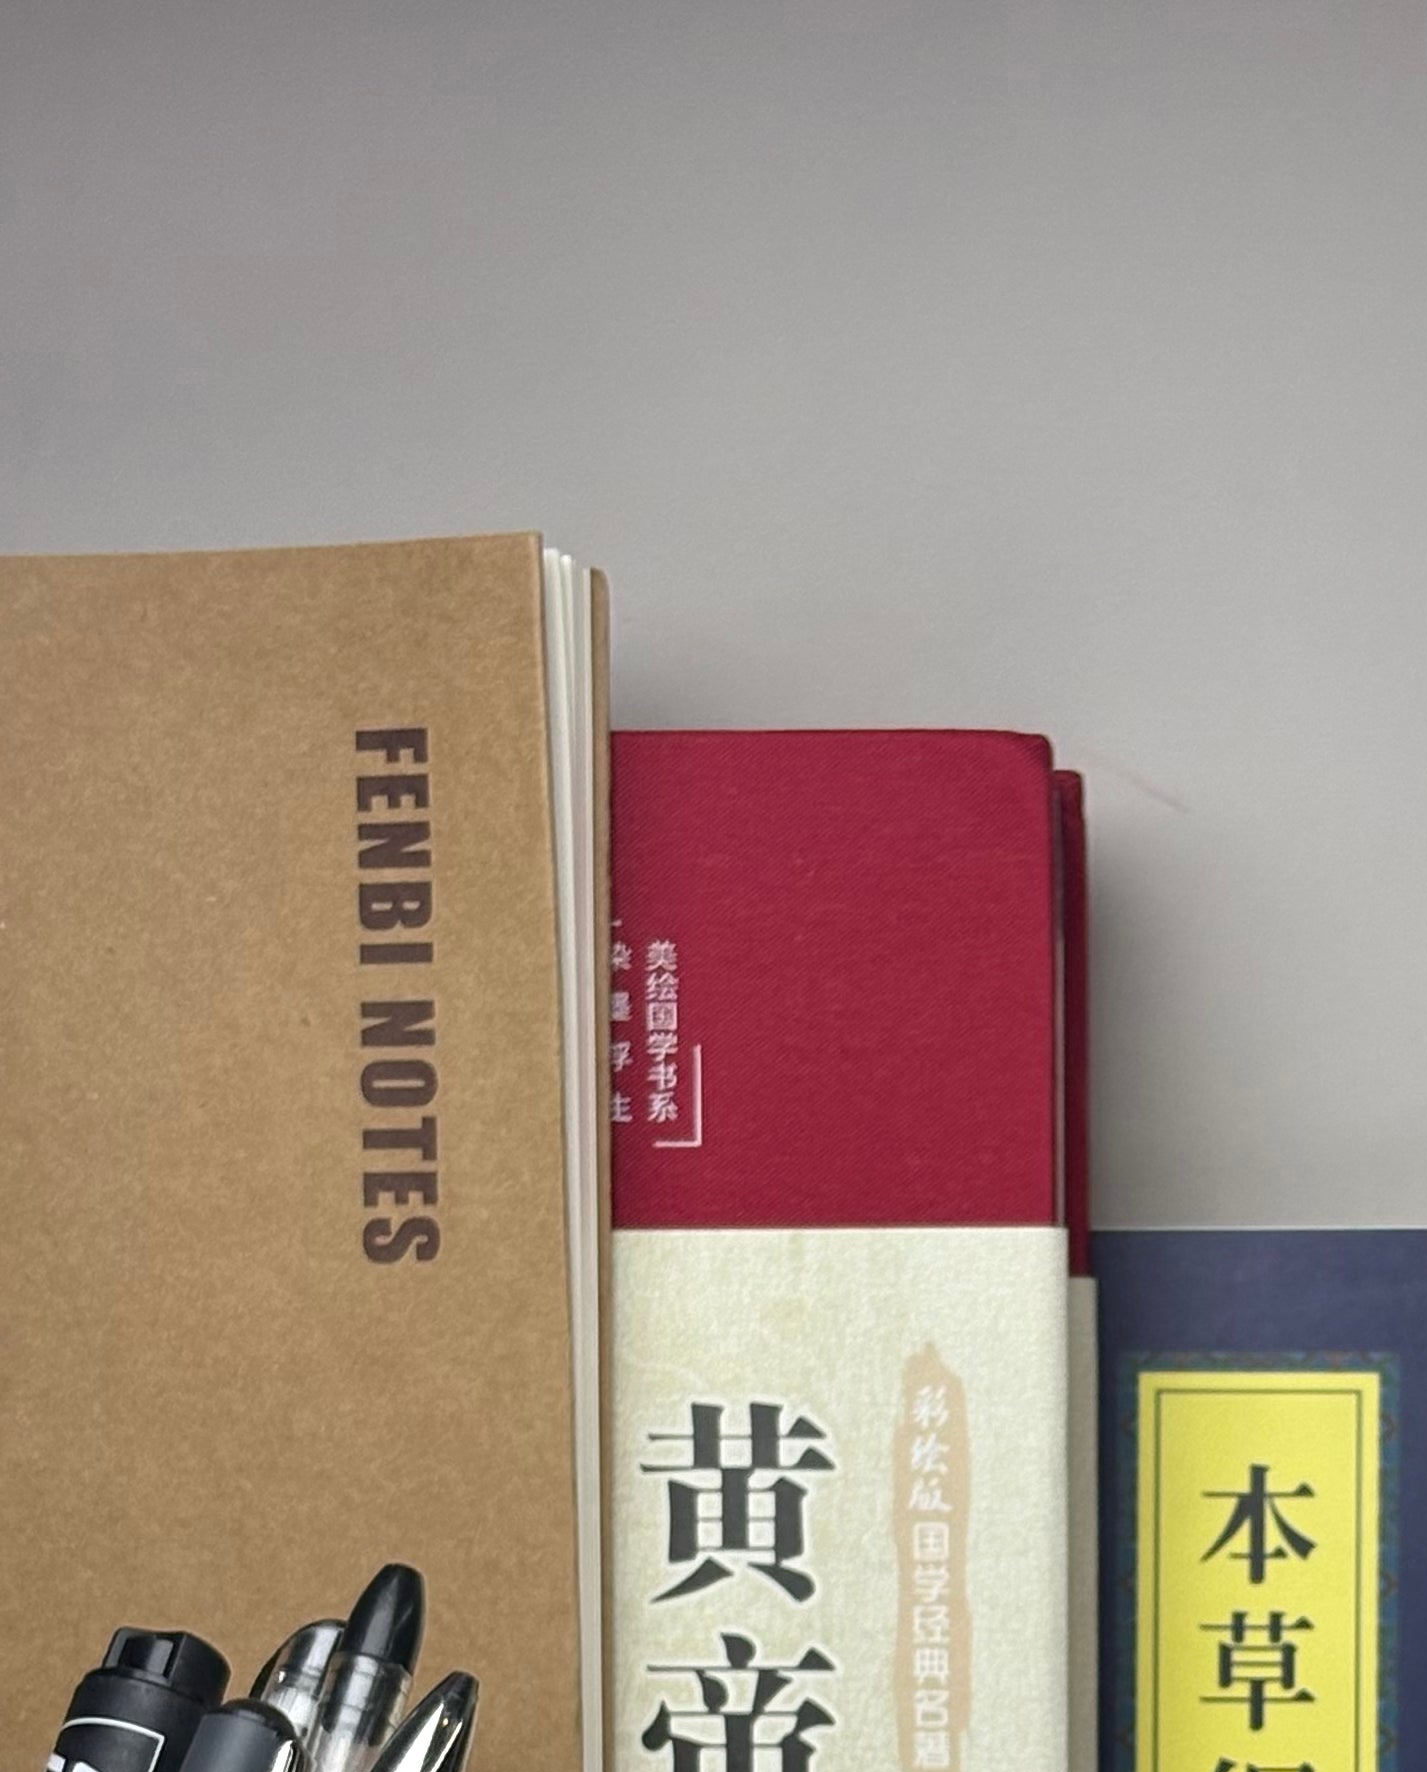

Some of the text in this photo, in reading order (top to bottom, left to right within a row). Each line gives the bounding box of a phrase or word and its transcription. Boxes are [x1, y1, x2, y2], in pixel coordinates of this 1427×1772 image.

[354, 727, 442, 1264] FENBI NOTES
[645, 939, 679, 1123] 美绘国学书系
